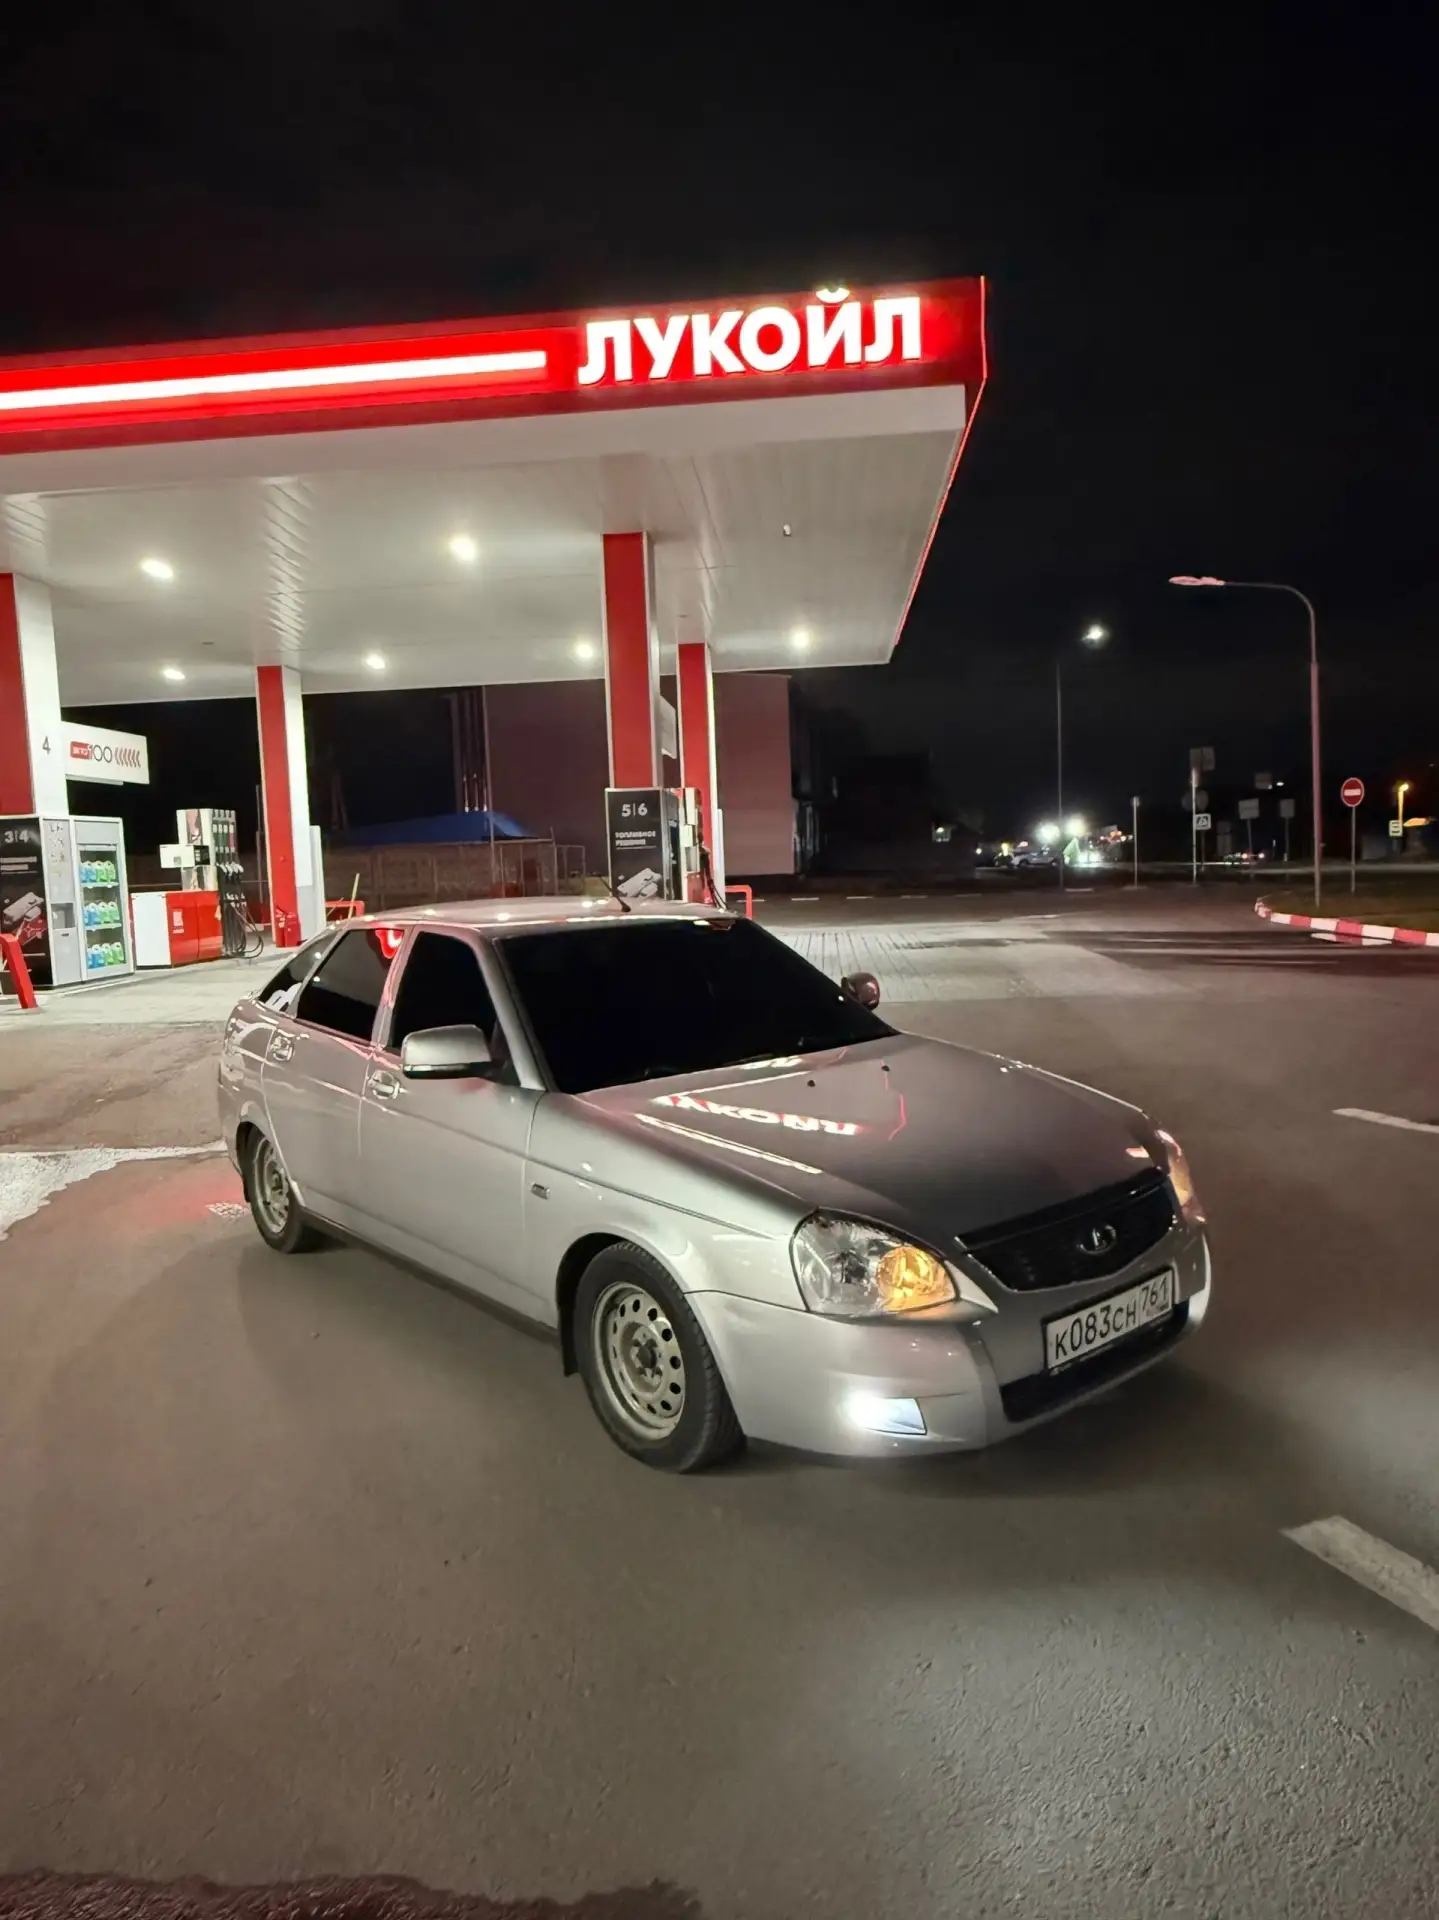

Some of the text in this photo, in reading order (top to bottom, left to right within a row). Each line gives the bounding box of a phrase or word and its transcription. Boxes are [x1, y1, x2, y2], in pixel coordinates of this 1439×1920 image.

[578, 286, 921, 385] ЛУКОЙЛ
[42, 736, 51, 754] 4
[1141, 1276, 1167, 1312] 761
